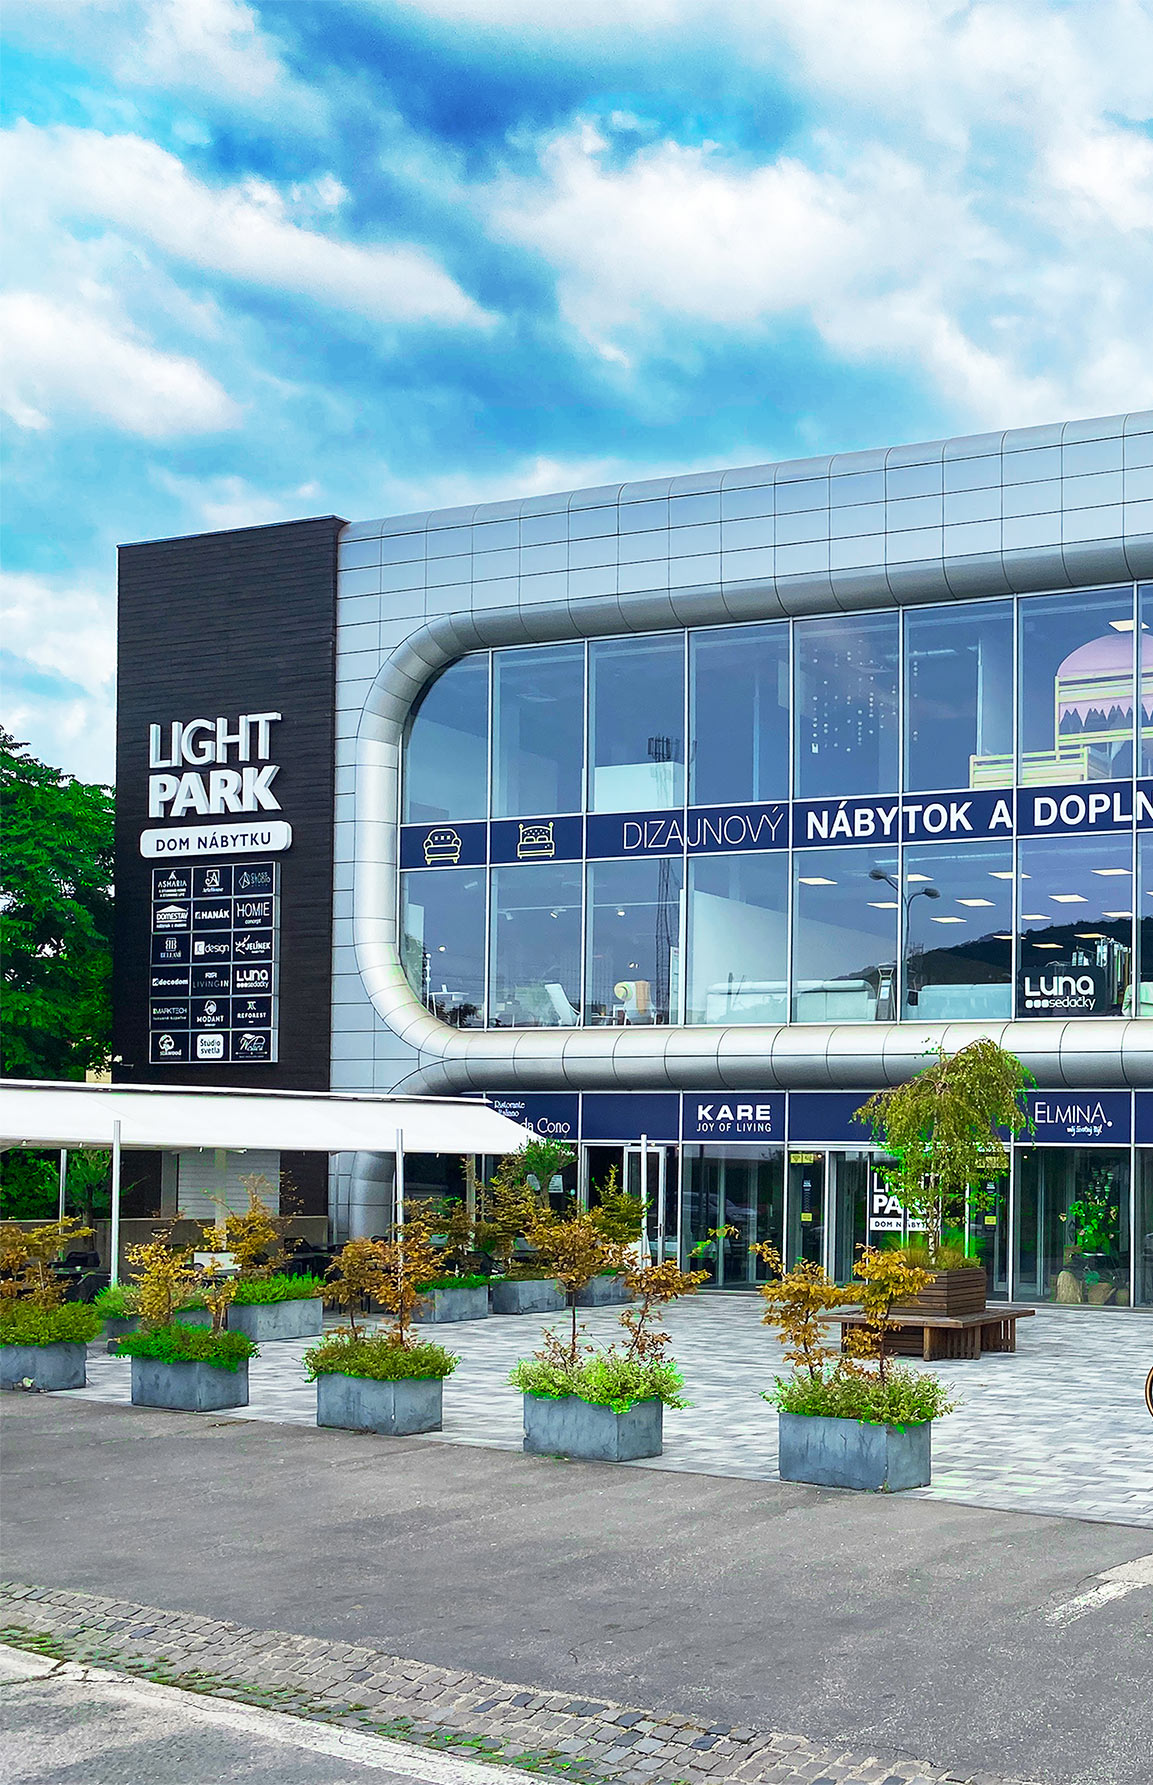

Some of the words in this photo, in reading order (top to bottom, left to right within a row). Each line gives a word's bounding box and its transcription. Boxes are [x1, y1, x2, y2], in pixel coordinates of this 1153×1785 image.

[149, 712, 282, 769] LIGHT
[148, 765, 282, 818] PARK
[623, 806, 784, 850] DIZAJNOVÝ
[807, 801, 973, 839] NÁBYTOK
[988, 800, 1013, 829] A
[156, 837, 190, 852] DOM
[197, 831, 271, 850] NÁBYTKU
[202, 908, 230, 919] HANÁK
[236, 902, 270, 918] HOME
[205, 943, 230, 955] design
[1025, 975, 1095, 997] Luna
[1049, 996, 1096, 1011] sedačky
[697, 1104, 771, 1121] KARE
[1034, 1101, 1107, 1124] ELMINA
[537, 1117, 571, 1134] Cono
[696, 1122, 715, 1132] JOY
[719, 1122, 732, 1132] OF
[736, 1122, 772, 1132] LIVING
[874, 1220, 893, 1228] DOM
